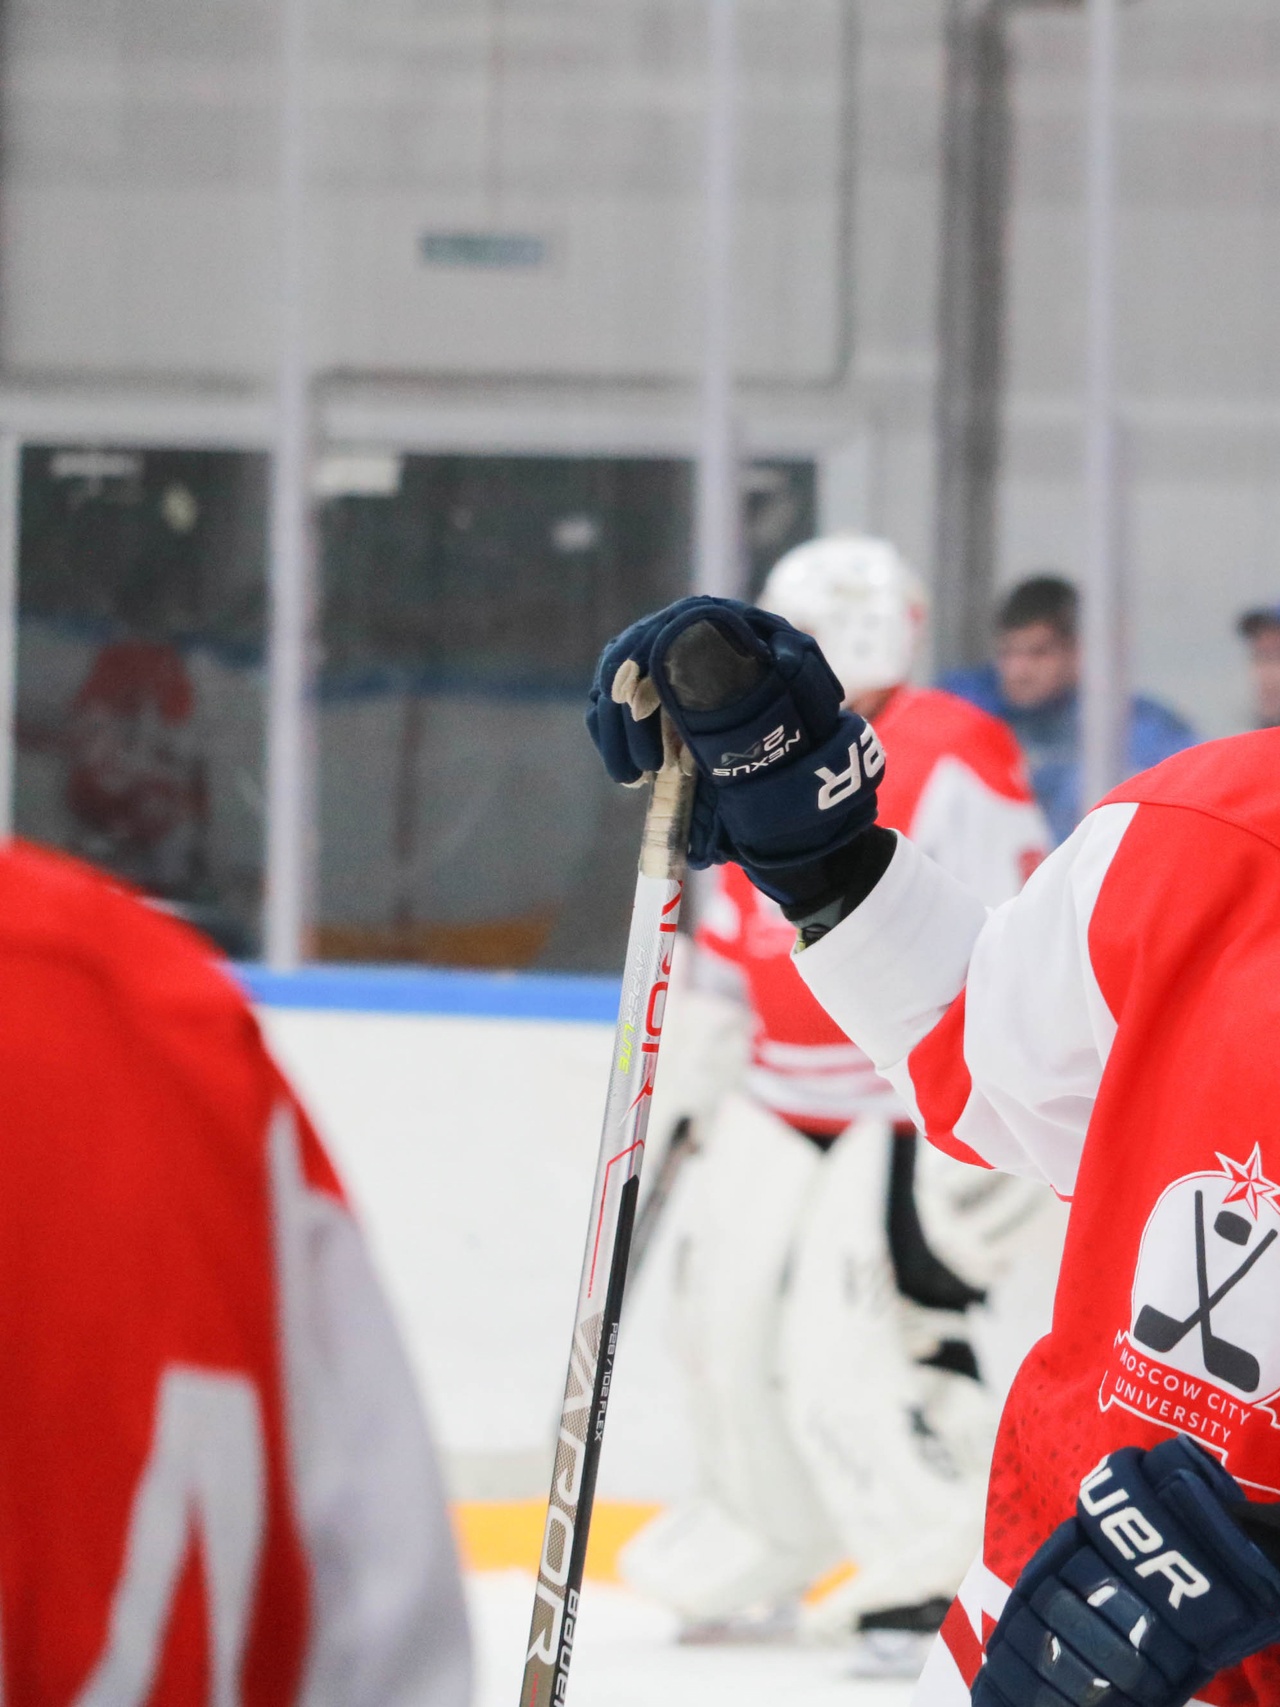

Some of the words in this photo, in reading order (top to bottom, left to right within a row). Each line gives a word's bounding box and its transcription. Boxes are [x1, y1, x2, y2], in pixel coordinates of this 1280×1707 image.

[712, 729, 801, 777] NEXUS
[1115, 1379, 1232, 1444] UNIVERSITY
[1119, 1349, 1202, 1400] MOSCOW
[1207, 1393, 1252, 1427] CITY
[594, 1400, 608, 1442] FLEX
[1079, 1454, 1211, 1610] UER
